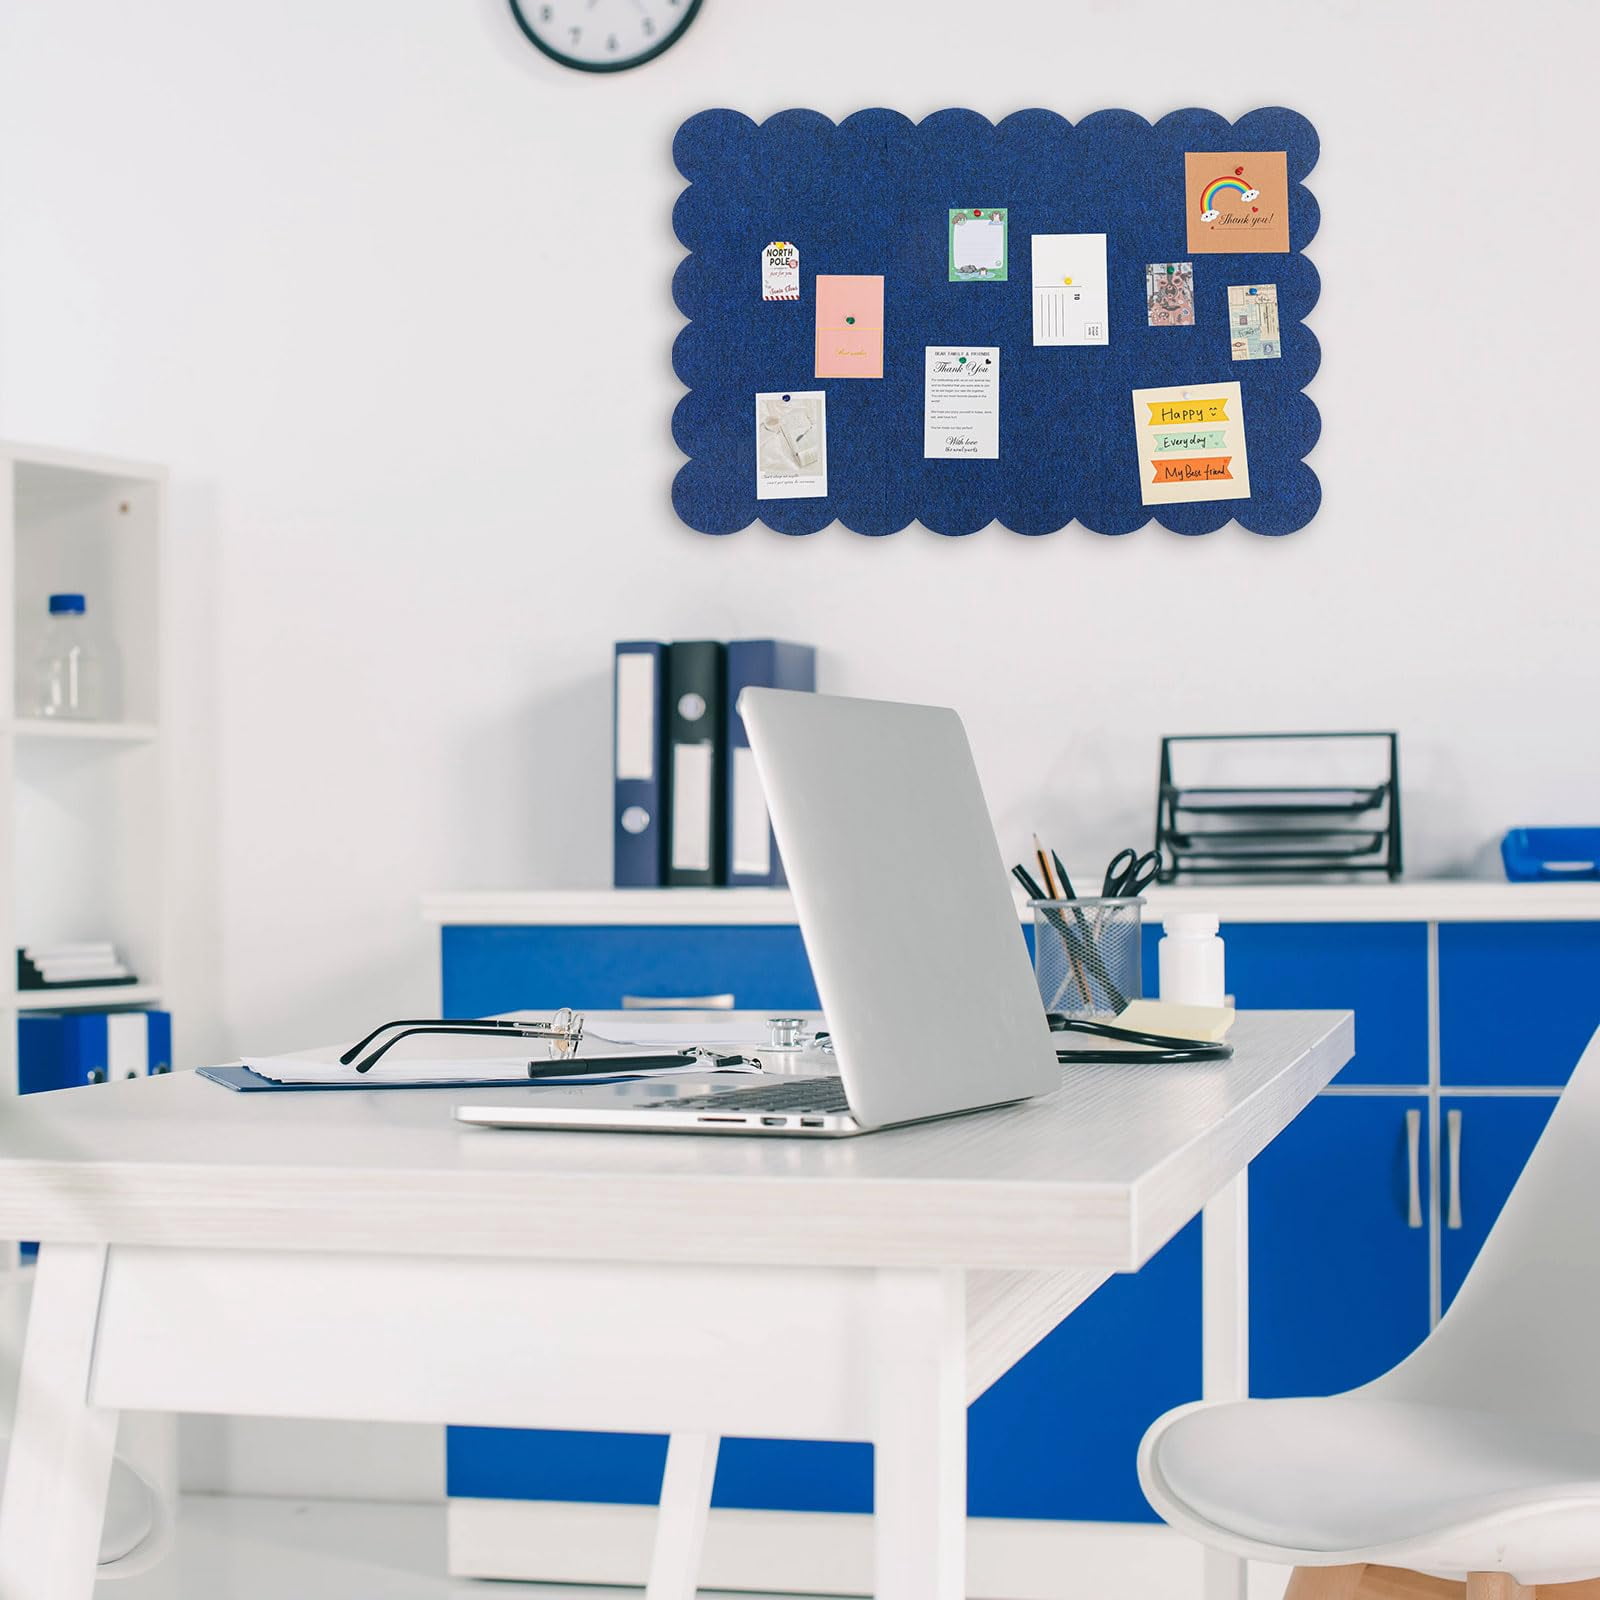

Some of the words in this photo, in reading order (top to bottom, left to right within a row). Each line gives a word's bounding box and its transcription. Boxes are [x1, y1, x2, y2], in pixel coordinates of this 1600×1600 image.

[1218, 213, 1249, 225] Thank
[1250, 213, 1274, 228] you!
[766, 248, 793, 257] NORTH
[769, 257, 791, 266] POLE
[933, 361, 963, 373] Thank
[966, 361, 989, 376] You
[1161, 408, 1204, 422] Happy
[945, 434, 965, 446] With
[1165, 467, 1184, 481] My
